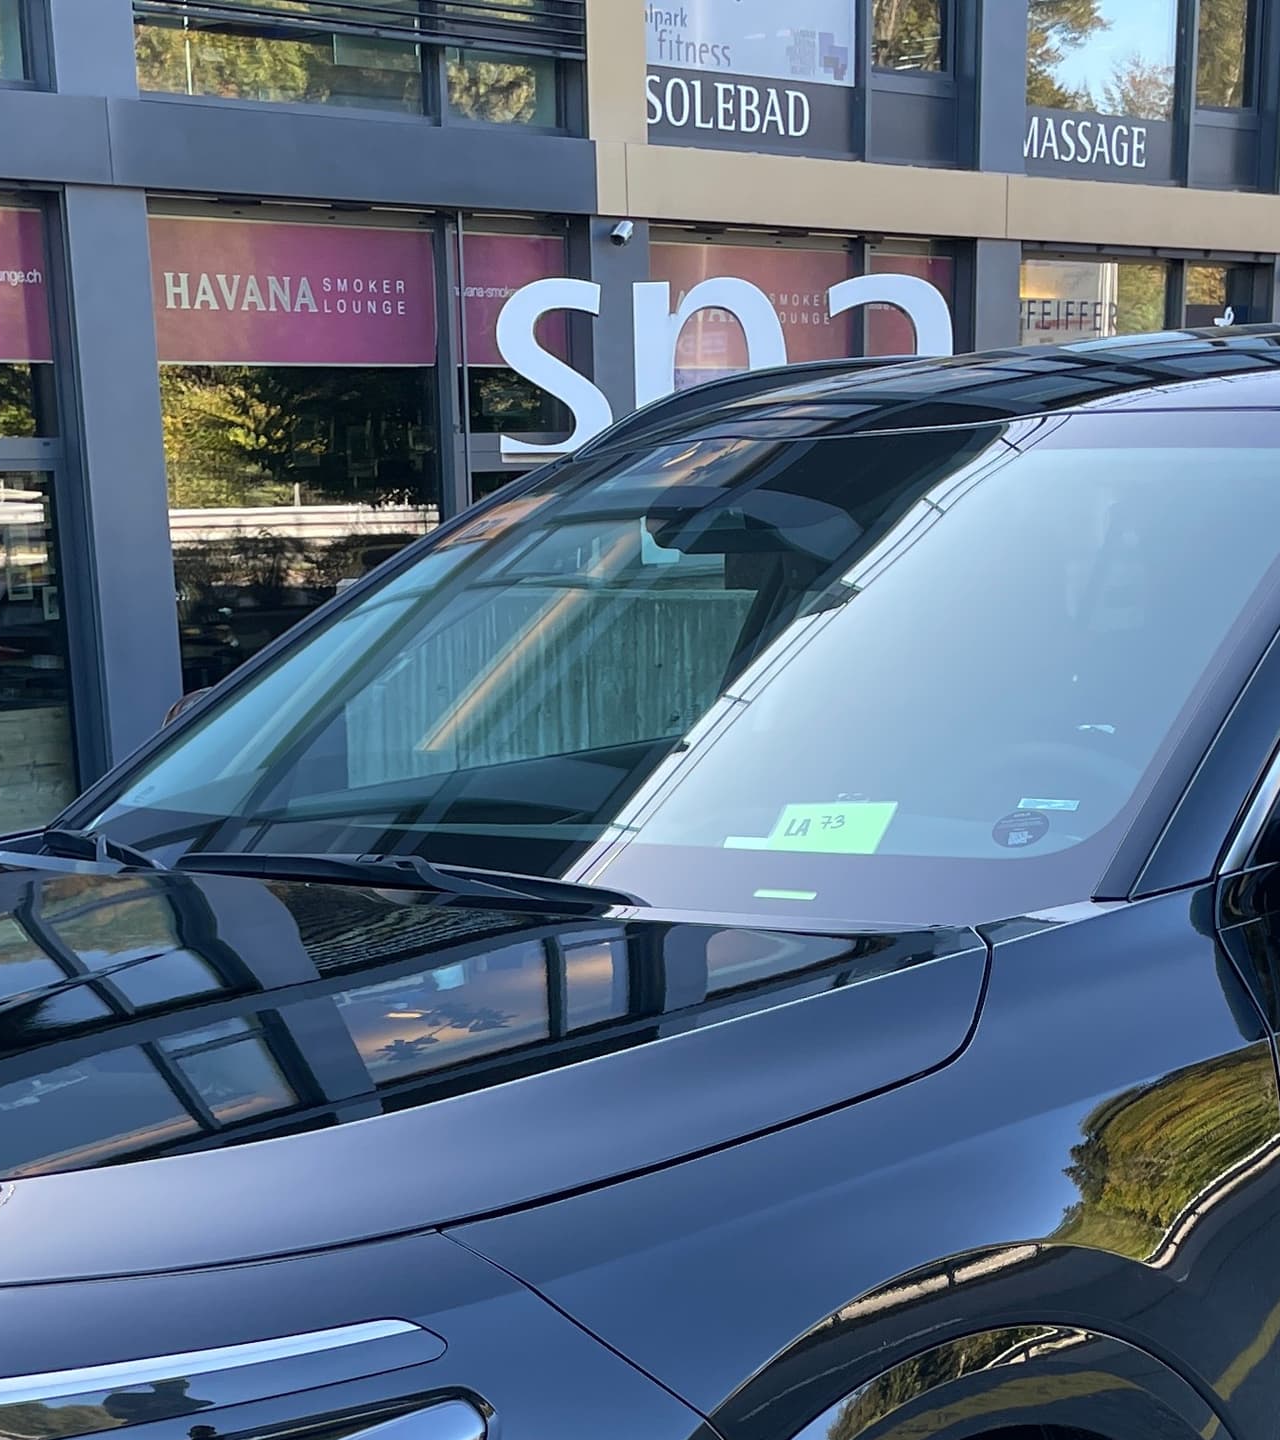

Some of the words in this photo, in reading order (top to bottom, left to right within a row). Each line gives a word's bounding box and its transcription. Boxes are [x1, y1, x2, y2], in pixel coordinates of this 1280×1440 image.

[645, 4, 687, 32] lpark
[657, 29, 731, 67] fitness
[646, 75, 810, 137] SOLEBAD
[1024, 116, 1147, 168] MASSAGE
[163, 272, 320, 313] HAVANA
[322, 277, 406, 295] SMOKER
[323, 299, 407, 316] LOUNGE
[780, 310, 831, 325] OUNGE
[1019, 300, 1119, 330] FEIFFER
[783, 817, 812, 838] LA
[819, 813, 847, 830] 73
